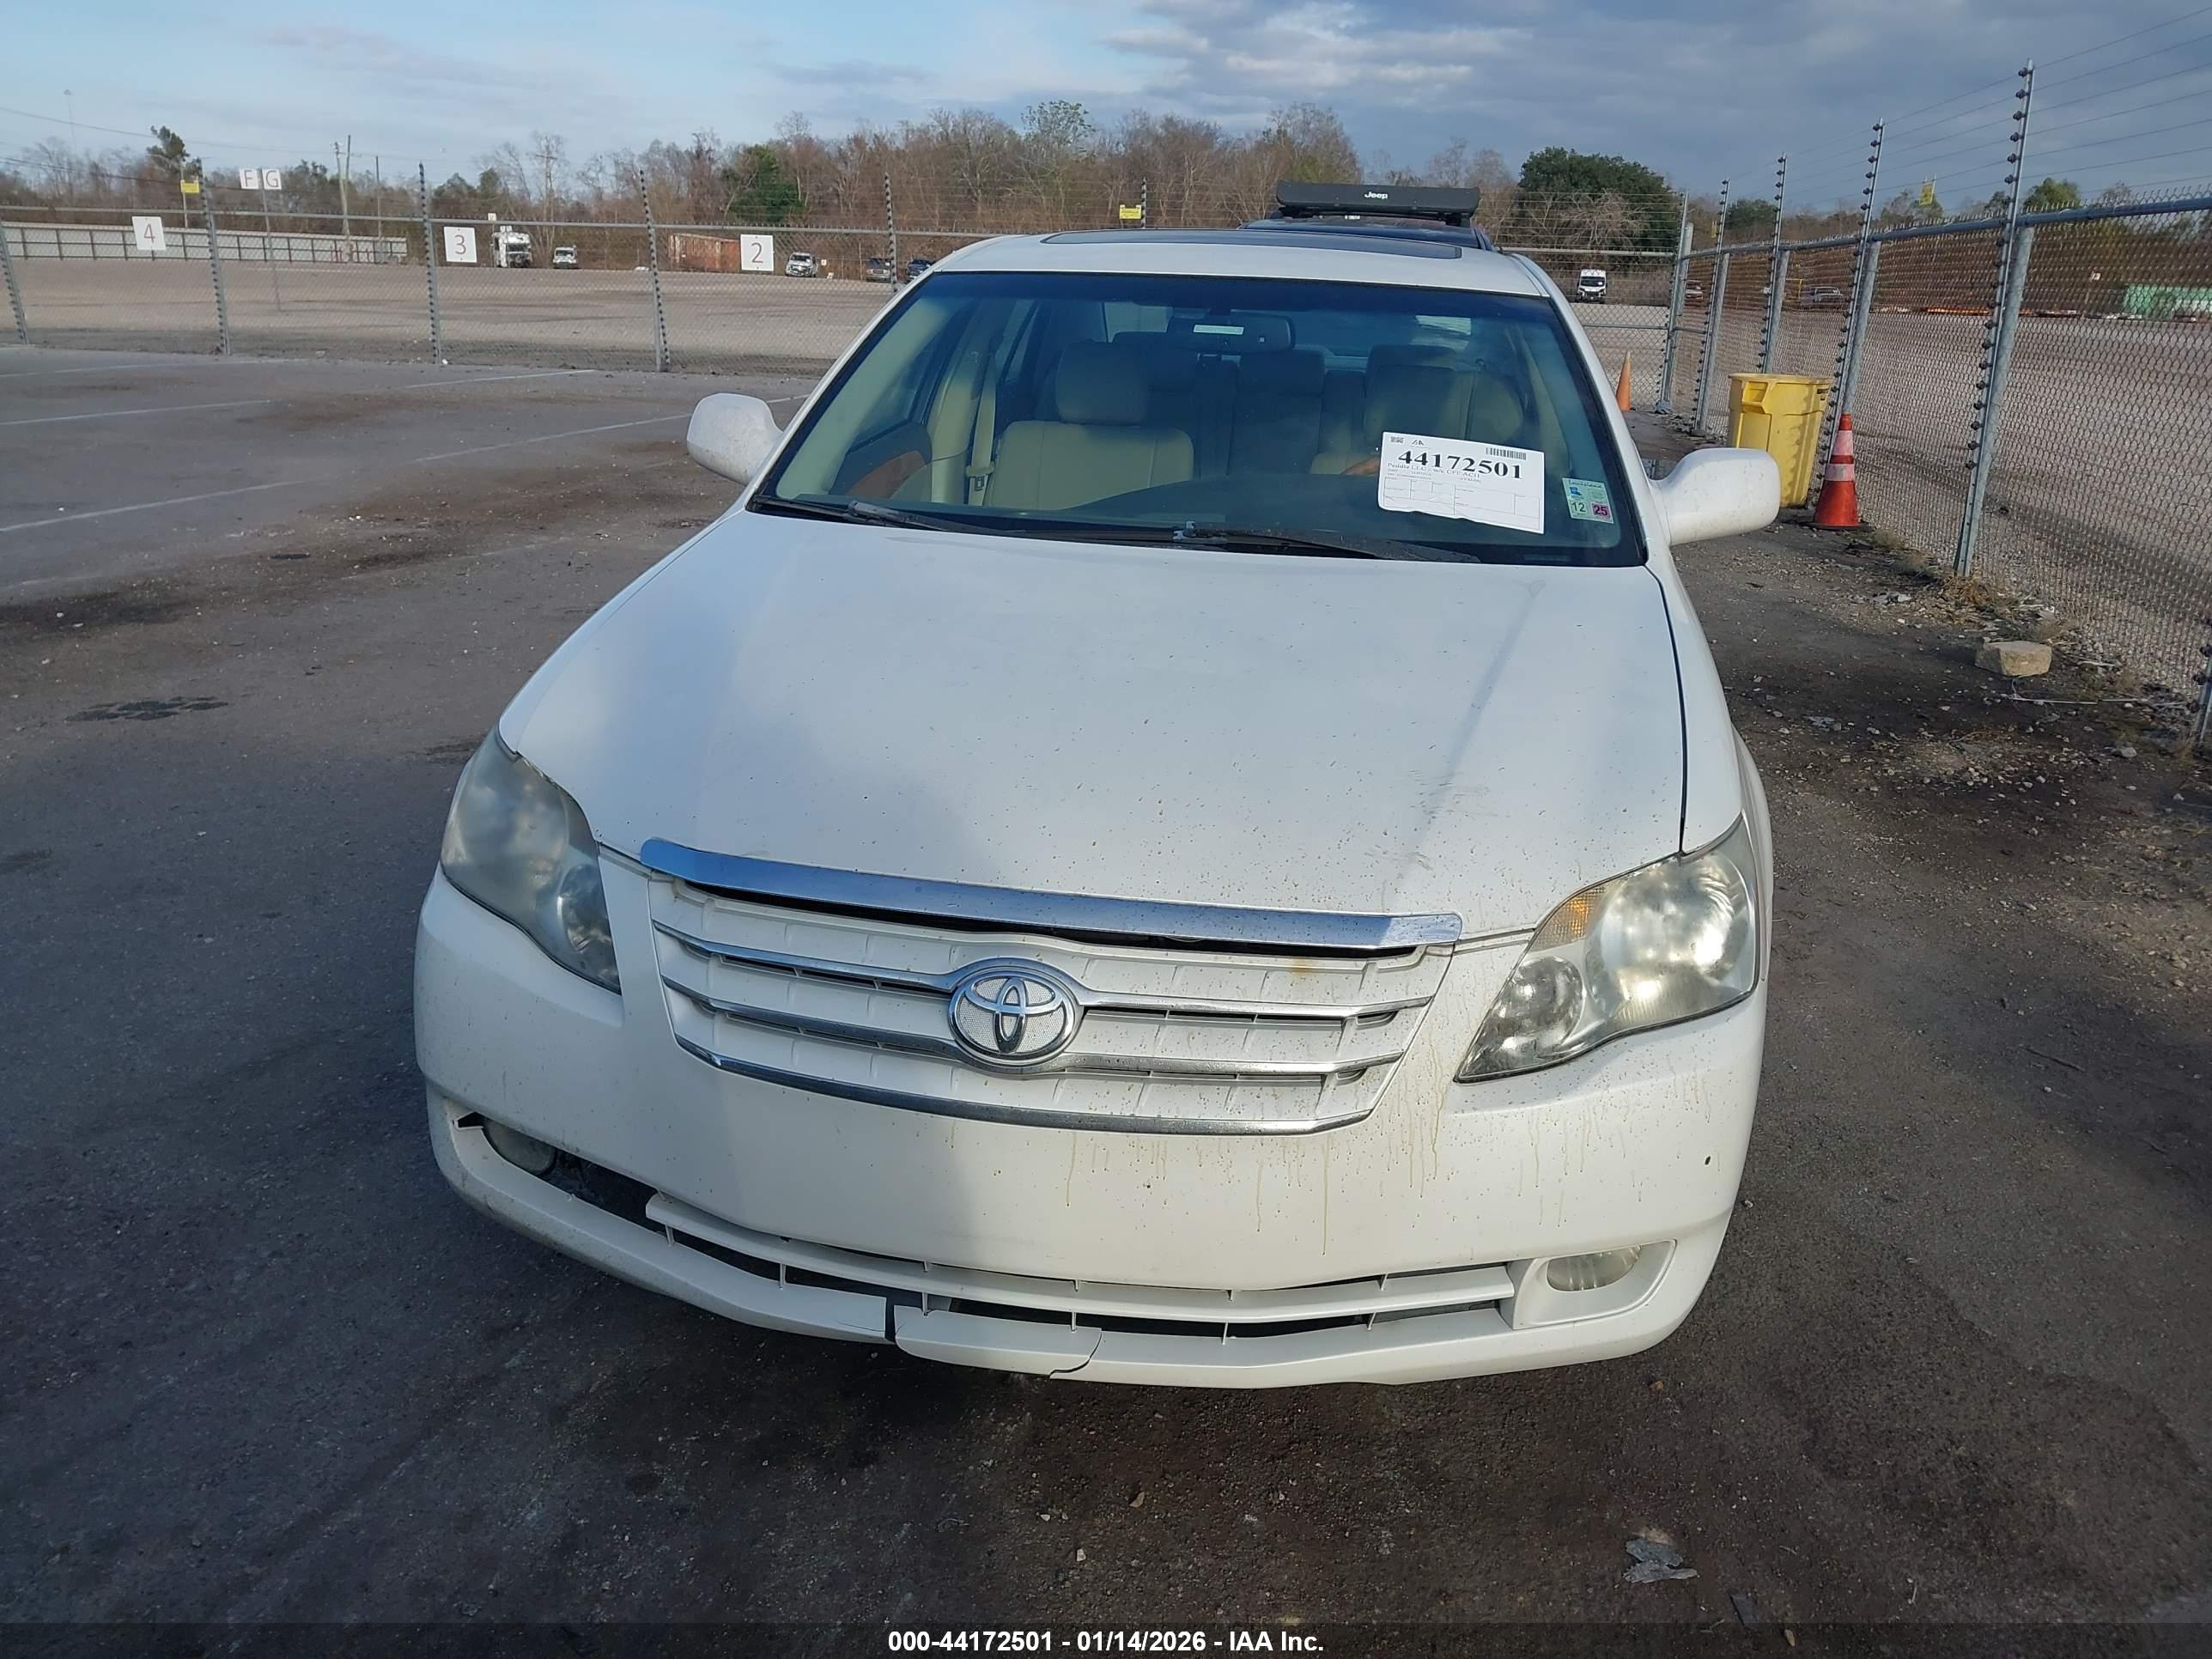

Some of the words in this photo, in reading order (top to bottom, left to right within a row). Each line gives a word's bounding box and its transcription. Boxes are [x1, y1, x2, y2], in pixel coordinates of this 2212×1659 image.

[245, 169, 252, 188] F
[265, 170, 279, 188] G
[1364, 191, 1389, 200] Jeep
[143, 223, 156, 243] 4
[453, 234, 467, 255] 3
[750, 242, 763, 264] 2
[1398, 450, 1523, 480] 44172501
[1571, 501, 1586, 513] 12
[1593, 504, 1608, 516] 25
